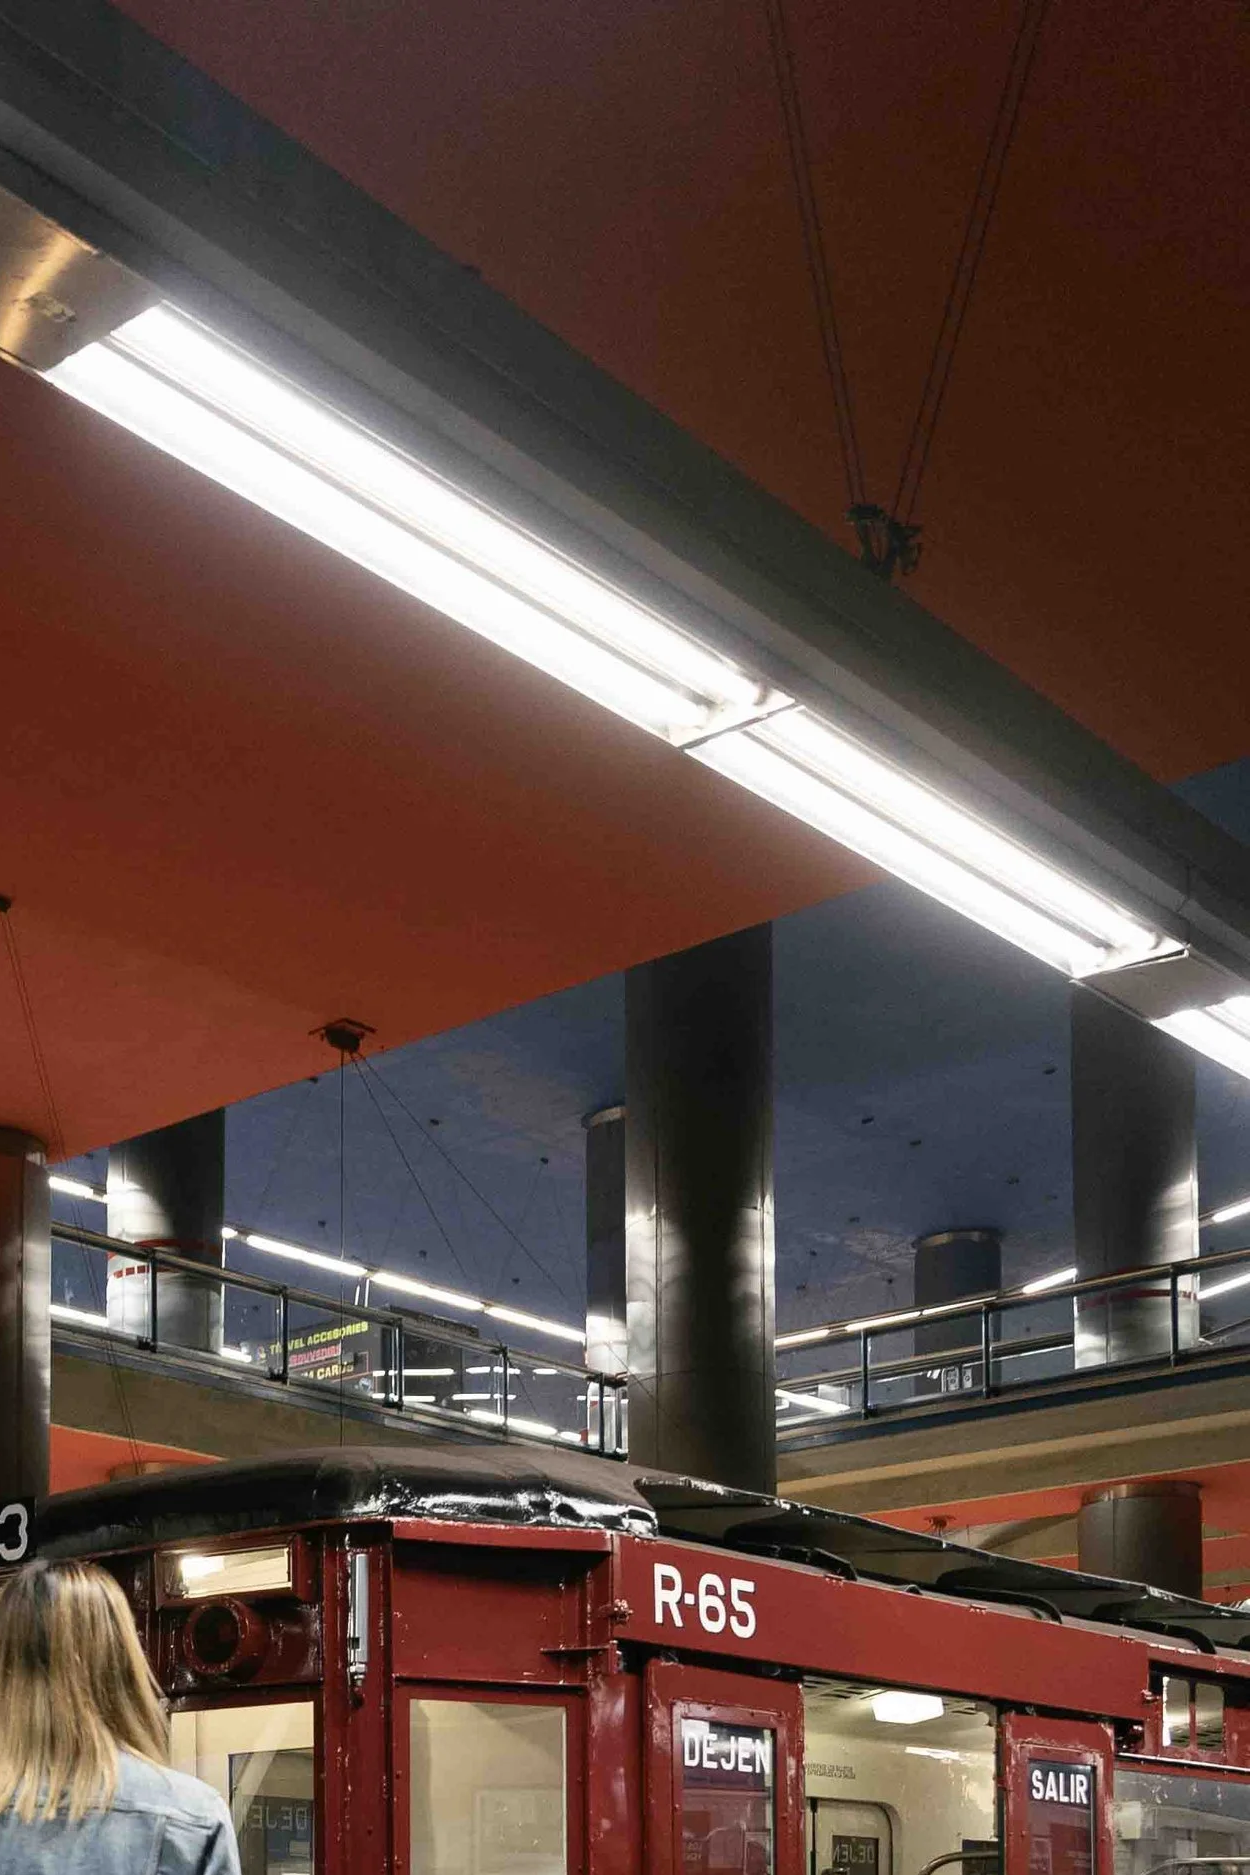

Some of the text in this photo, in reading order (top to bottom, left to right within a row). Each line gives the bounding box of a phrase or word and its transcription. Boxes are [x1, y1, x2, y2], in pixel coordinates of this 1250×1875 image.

[269, 1337, 305, 1355] TRVEL
[653, 1563, 756, 1639] R-65
[683, 1731, 772, 1774] DEJEN
[1031, 1769, 1088, 1804] SALIR
